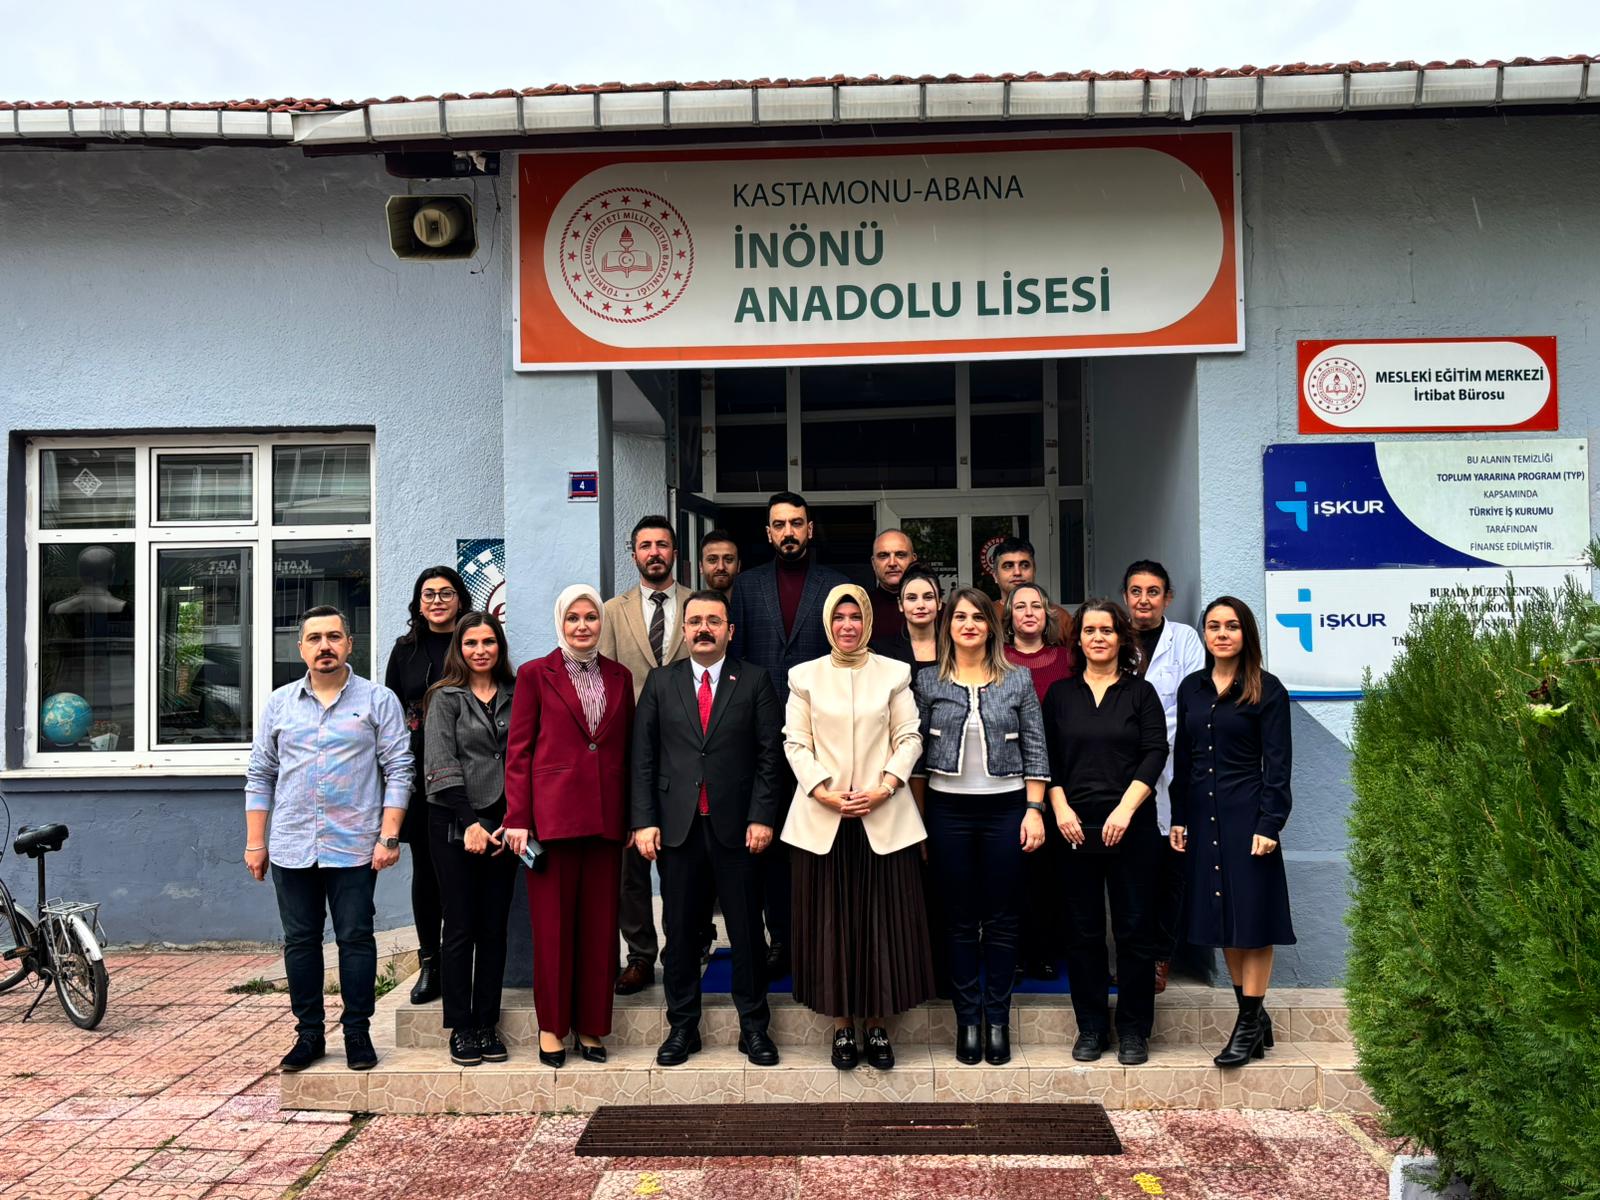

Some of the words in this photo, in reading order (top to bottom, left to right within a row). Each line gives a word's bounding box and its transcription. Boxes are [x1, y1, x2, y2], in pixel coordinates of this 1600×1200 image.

[733, 175, 1024, 208] KASTAMONU-ABANA
[623, 212, 649, 224] MİLLİ
[585, 213, 620, 265] CUMHURİYETİ
[649, 222, 669, 252] EĞİTİM
[734, 220, 884, 269] İNÖNÜ
[588, 268, 618, 297] TÜRKİYE
[637, 255, 669, 296] BAKANLIĞI
[734, 281, 961, 324] ANADOLU
[976, 267, 1110, 316] LİSESİ
[1375, 368, 1432, 383] MESLEKİ
[1435, 367, 1482, 382] EĞİTİM
[1485, 366, 1544, 382] MERKEZİ
[1414, 387, 1456, 401] İrtibat
[1458, 388, 1505, 401] Bürosu
[1467, 455, 1478, 464] BU
[1480, 455, 1511, 464] ALANIN
[1513, 453, 1553, 463] TEMİZLİĞİ
[1437, 473, 1472, 482] TOPLUM
[1474, 473, 1515, 481] YARARINA
[1517, 472, 1561, 481] PROGRAM
[1563, 471, 1585, 482] (TYP)
[579, 480, 585, 490] 4
[1483, 490, 1538, 499] KAPSAMINDA
[1469, 505, 1504, 516] TÜRKİYE
[1505, 505, 1513, 517] İŞ
[1514, 507, 1554, 516] KURUMU
[1485, 524, 1538, 534] TARAFINDAN
[1470, 541, 1504, 551] FİNANSE
[1506, 540, 1554, 552] EDİLMİŞTİR.
